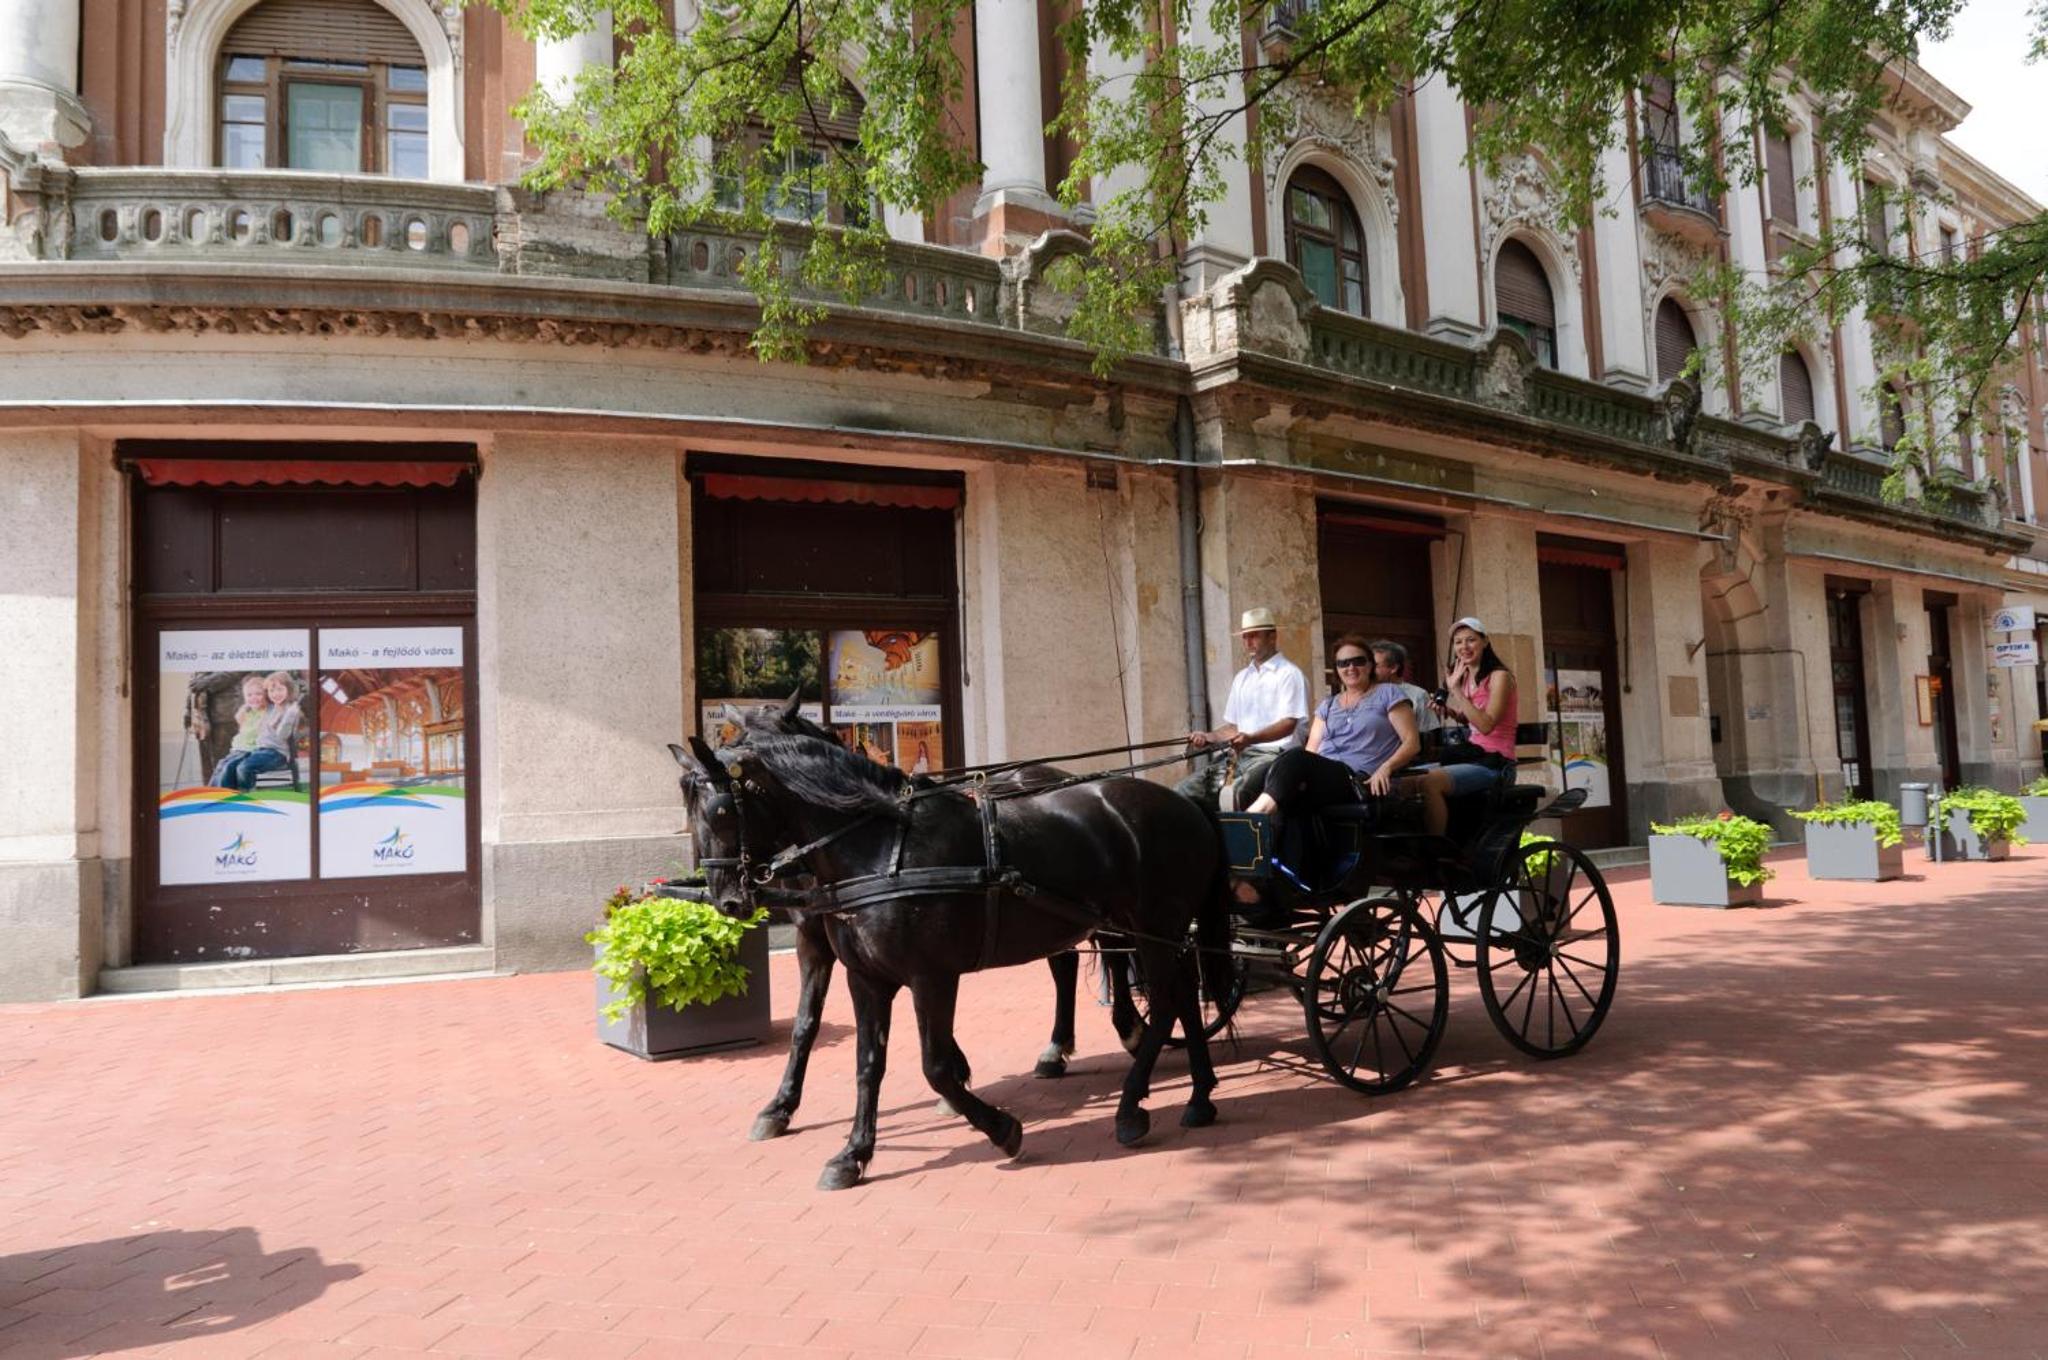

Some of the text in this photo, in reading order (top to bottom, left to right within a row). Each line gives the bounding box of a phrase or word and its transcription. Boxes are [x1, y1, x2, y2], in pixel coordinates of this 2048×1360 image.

[328, 647, 359, 658] Makó
[371, 649, 379, 657] a
[424, 646, 454, 656] város
[1996, 643, 2030, 652] OPTIKA
[166, 650, 197, 660] Makó
[211, 651, 224, 660] az
[272, 648, 304, 659] város
